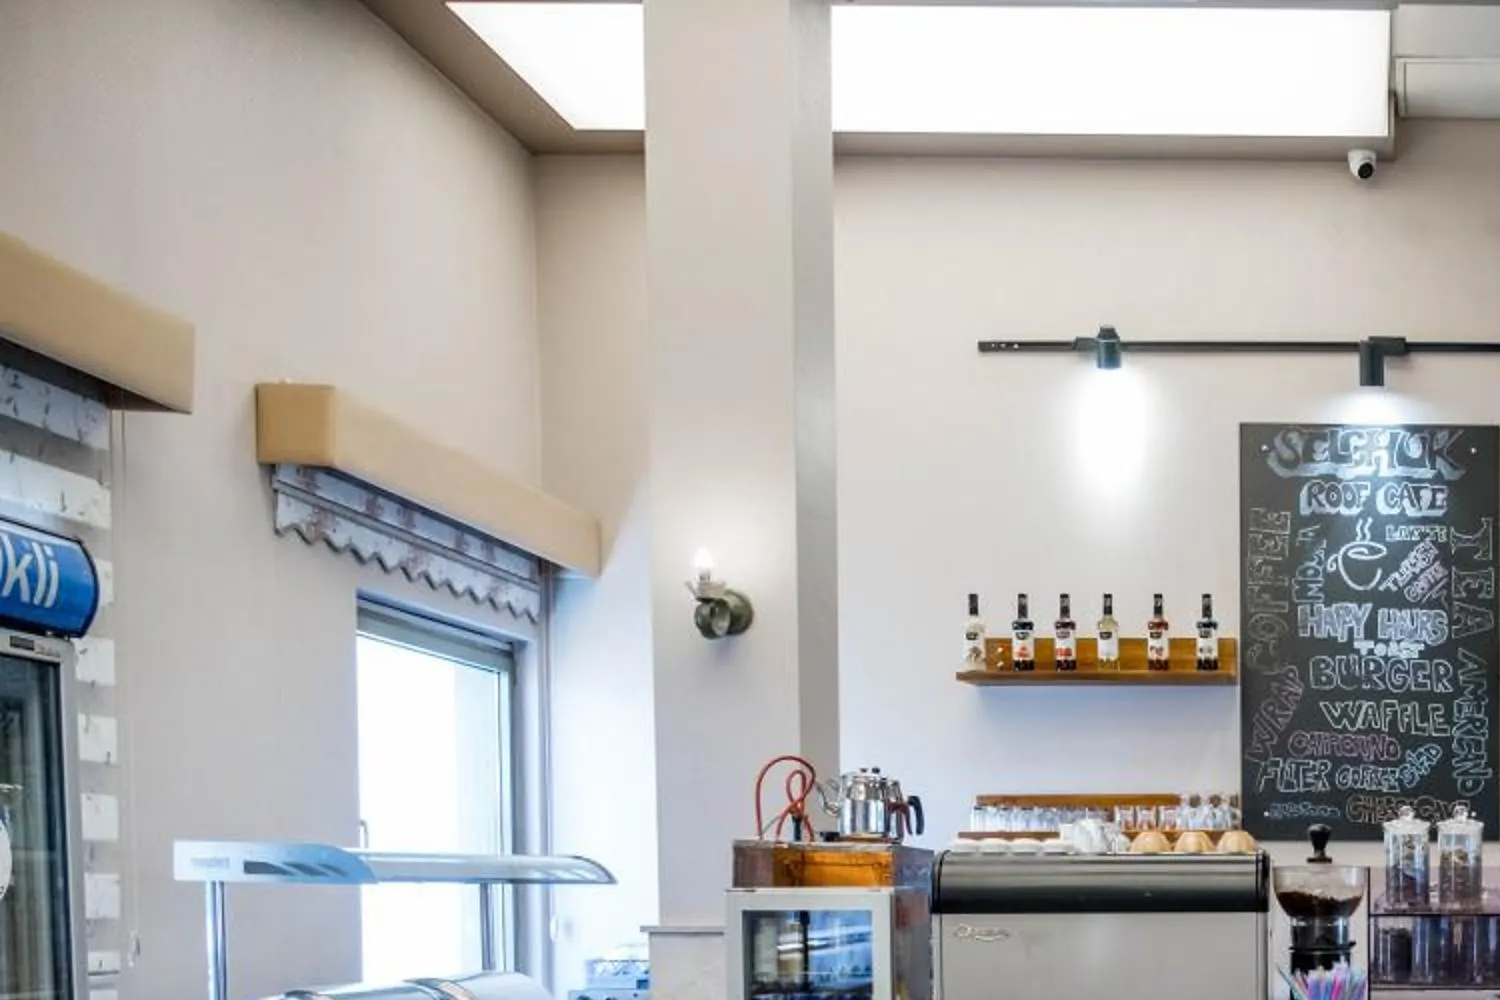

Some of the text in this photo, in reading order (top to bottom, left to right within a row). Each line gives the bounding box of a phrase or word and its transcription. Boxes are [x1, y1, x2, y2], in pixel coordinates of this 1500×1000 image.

[1300, 481, 1449, 517] ROOF CAFE
[1248, 507, 1292, 674] COFFEE
[1450, 517, 1495, 639] TEA
[1309, 656, 1454, 693] BURGER
[1319, 699, 1451, 737] WAFFLE
